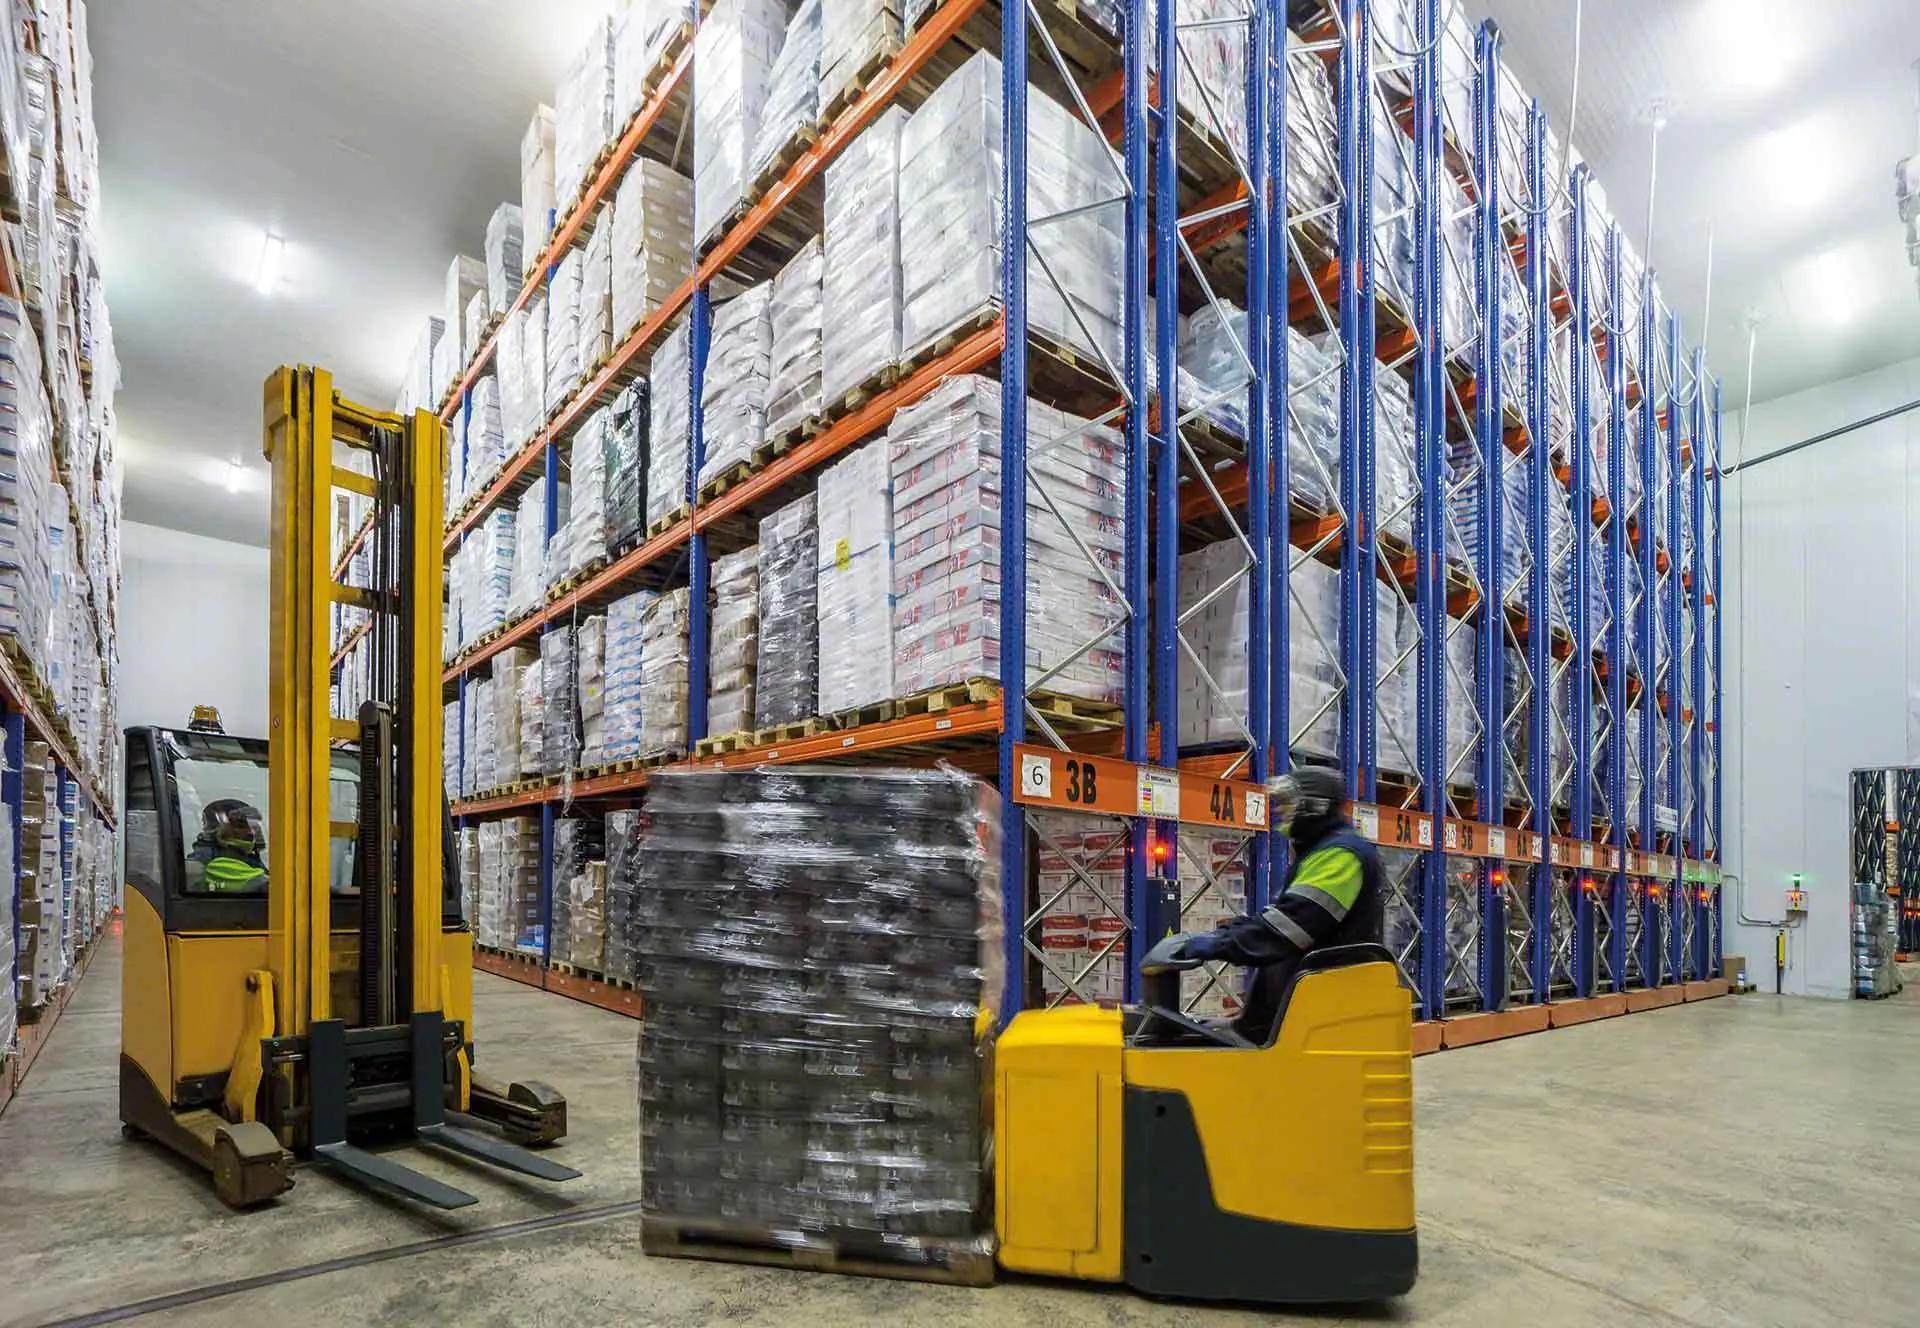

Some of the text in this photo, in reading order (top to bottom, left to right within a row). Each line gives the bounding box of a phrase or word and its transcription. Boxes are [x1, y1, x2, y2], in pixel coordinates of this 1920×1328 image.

[1032, 765, 1044, 786] 6
[1066, 759, 1097, 805] 3B
[1210, 783, 1235, 821] 4A
[1252, 799, 1260, 816] 7
[1396, 814, 1412, 843] 5A
